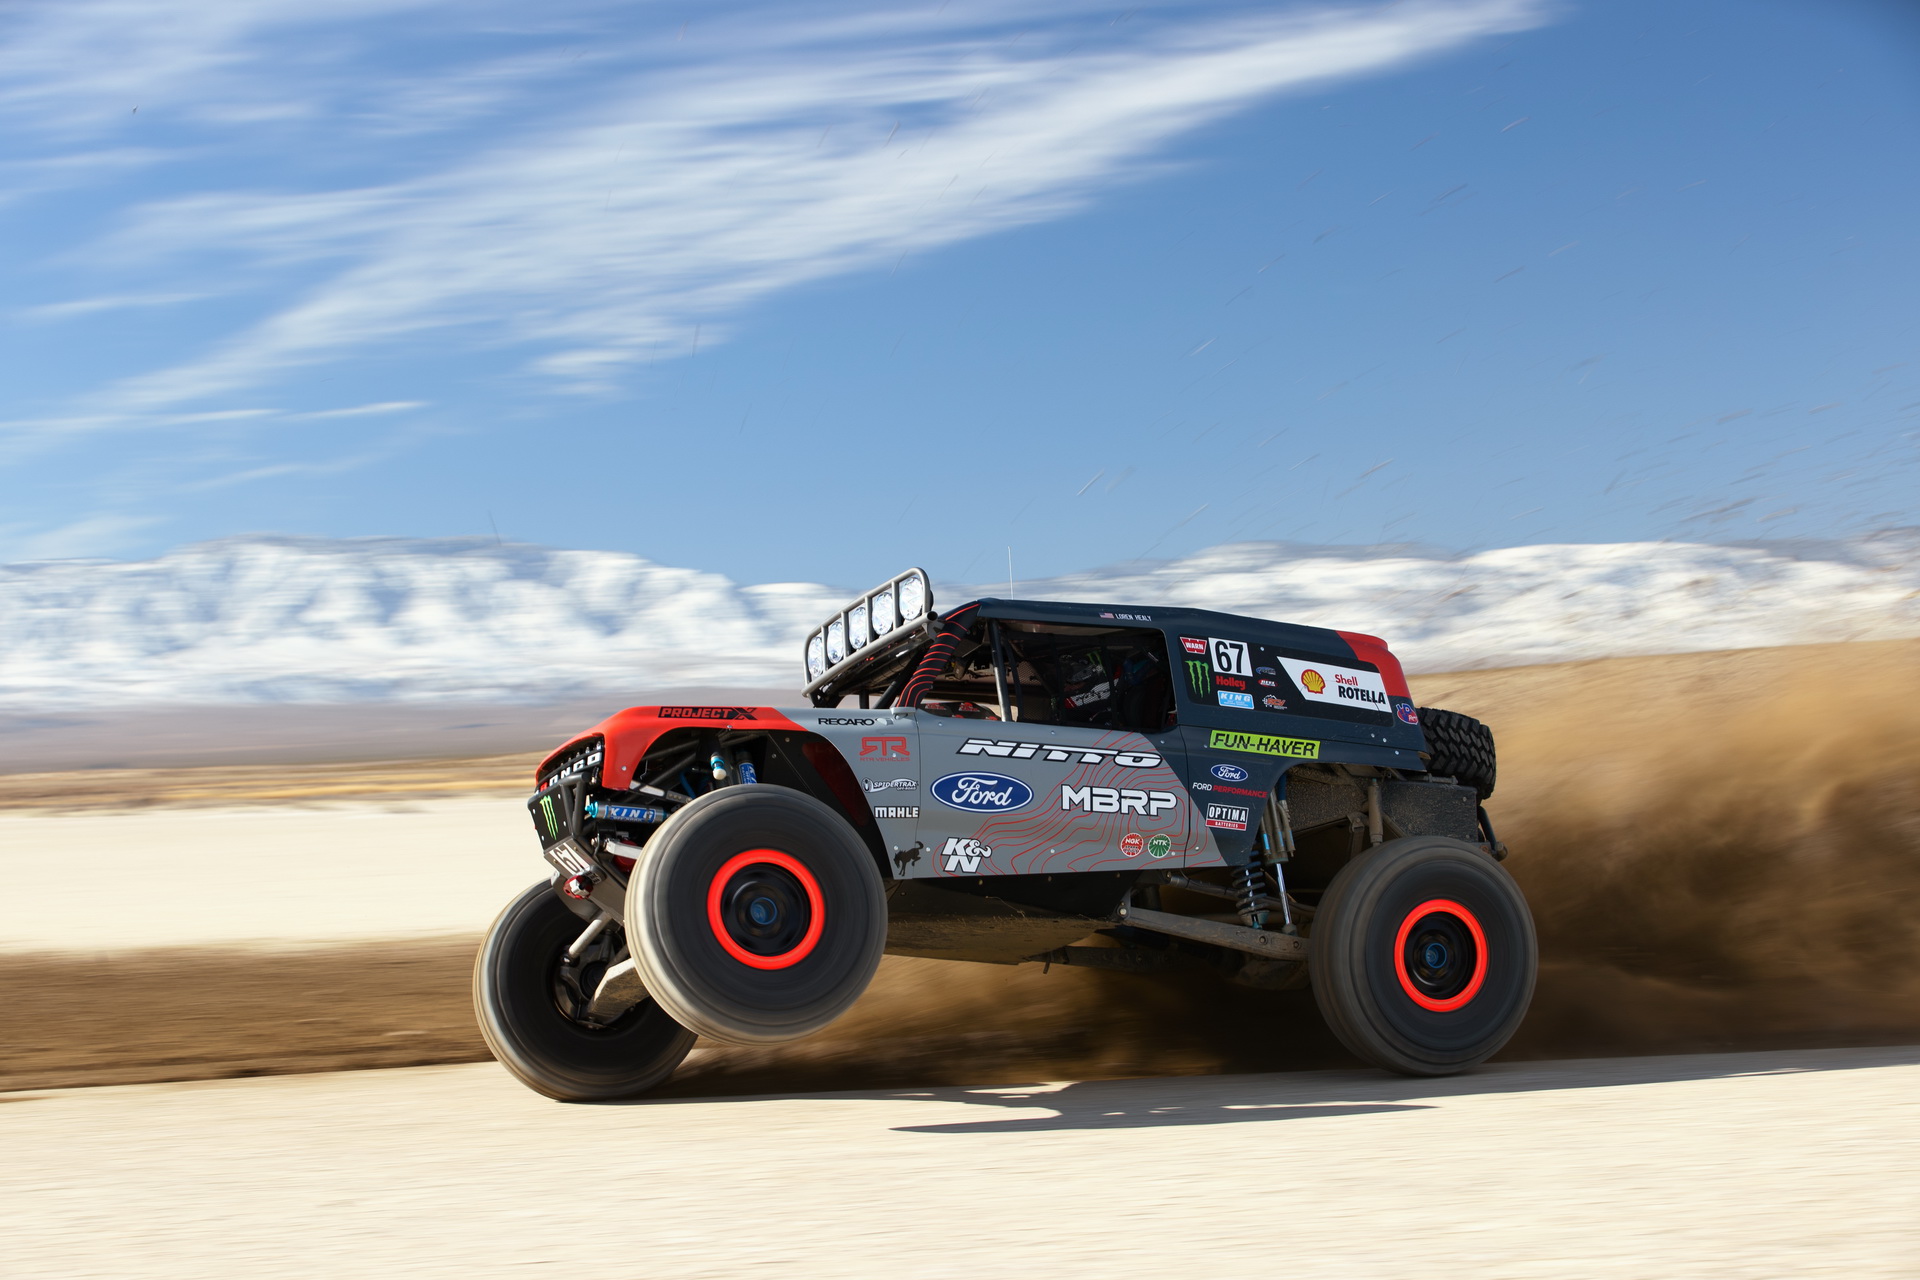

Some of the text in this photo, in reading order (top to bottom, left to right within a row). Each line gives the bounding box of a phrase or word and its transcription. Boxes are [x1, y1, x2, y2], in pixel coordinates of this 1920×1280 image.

[1134, 614, 1152, 622] HEALY
[1185, 641, 1204, 651] WARN
[1215, 640, 1244, 674] 67
[1216, 675, 1246, 691] Holley
[1335, 673, 1358, 686] Shell
[1220, 692, 1251, 702] KING
[1338, 685, 1386, 704] ROTELLA
[818, 718, 875, 726] RECARO
[1213, 733, 1315, 756] FUN-HAVER
[956, 738, 1163, 768] NITTO
[1217, 765, 1241, 780] Ford
[873, 780, 917, 788] SPIDERTRAX
[951, 777, 1013, 806] Ford
[1192, 782, 1268, 798] FORD PERFORMANCE
[1061, 784, 1177, 816] MBRP
[874, 806, 919, 818] MAHLE
[1208, 806, 1246, 822] OPTIMA
[553, 844, 585, 873] 67
